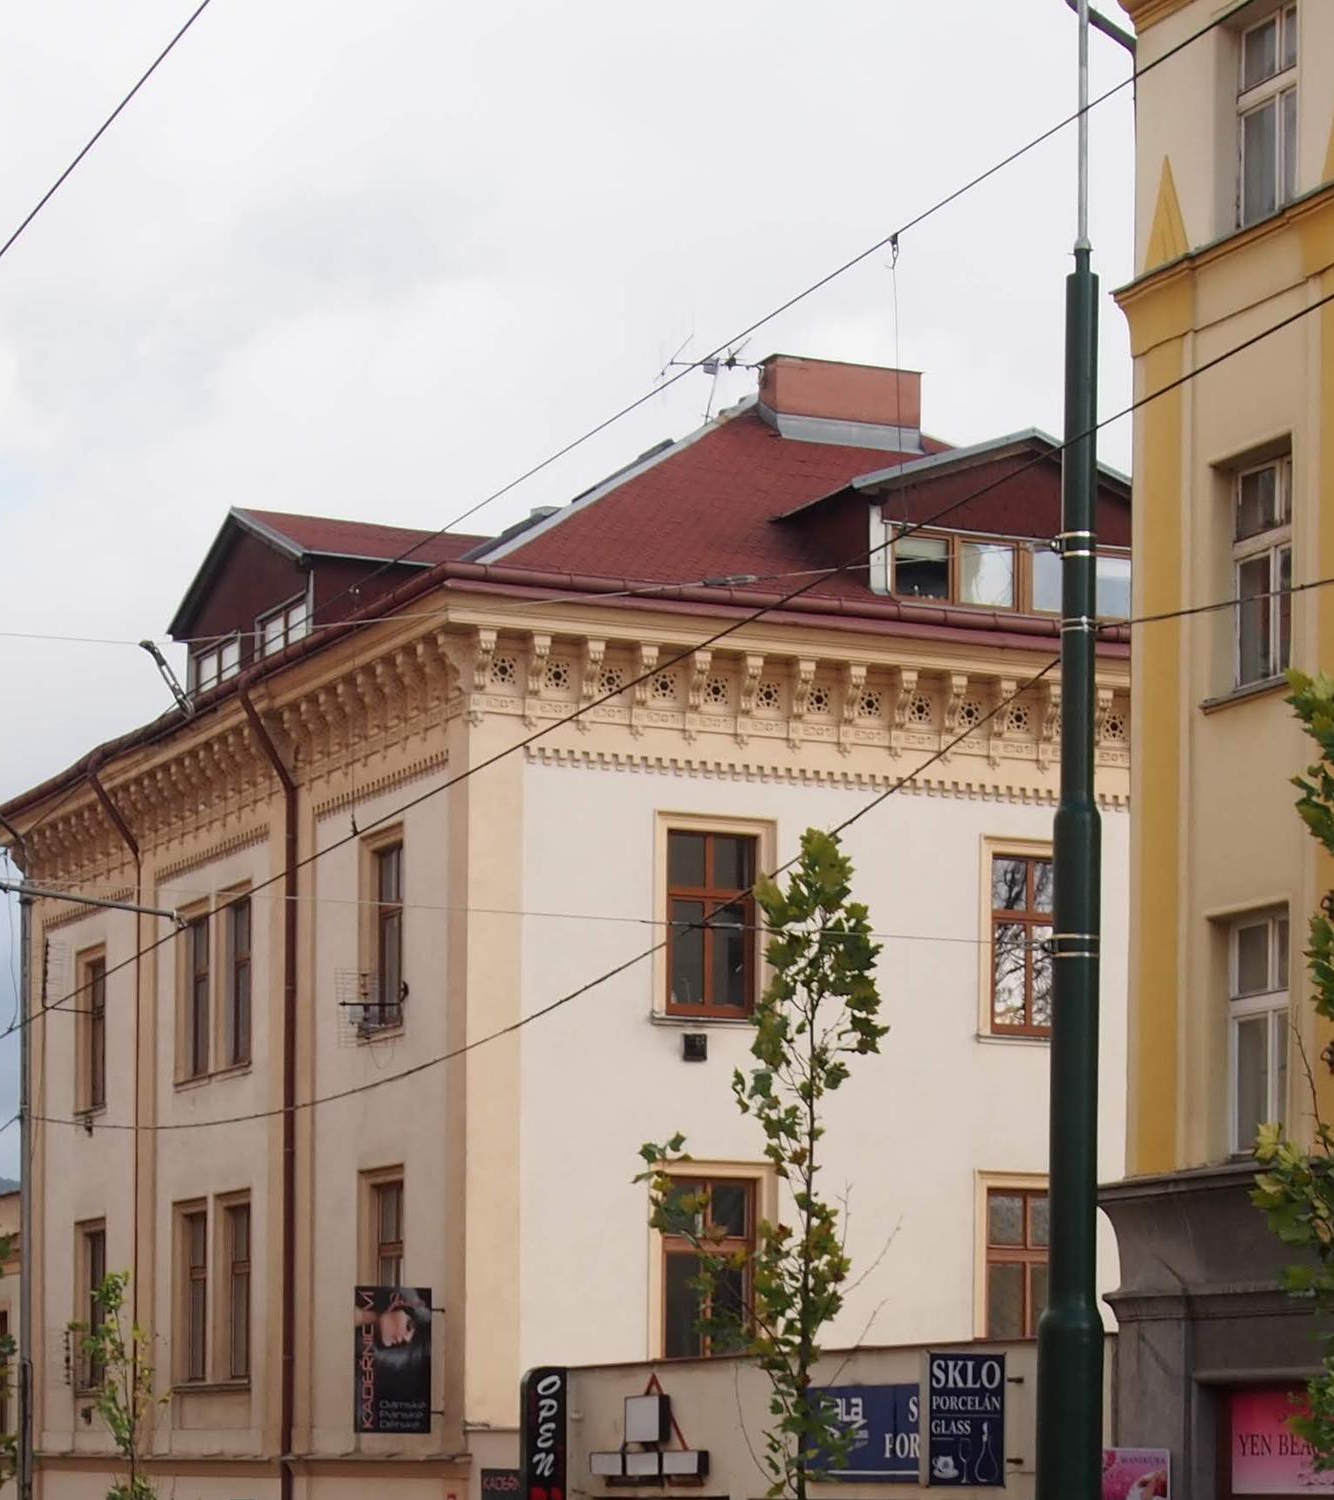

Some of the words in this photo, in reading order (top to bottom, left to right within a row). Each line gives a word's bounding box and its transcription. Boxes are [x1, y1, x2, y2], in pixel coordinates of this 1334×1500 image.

[932, 1360, 1001, 1389] SKLO
[932, 1393, 1001, 1411] PORCELÁN
[532, 1374, 562, 1477] OPEN
[931, 1419, 971, 1435] GLASS
[1239, 1434, 1272, 1456] YEN
